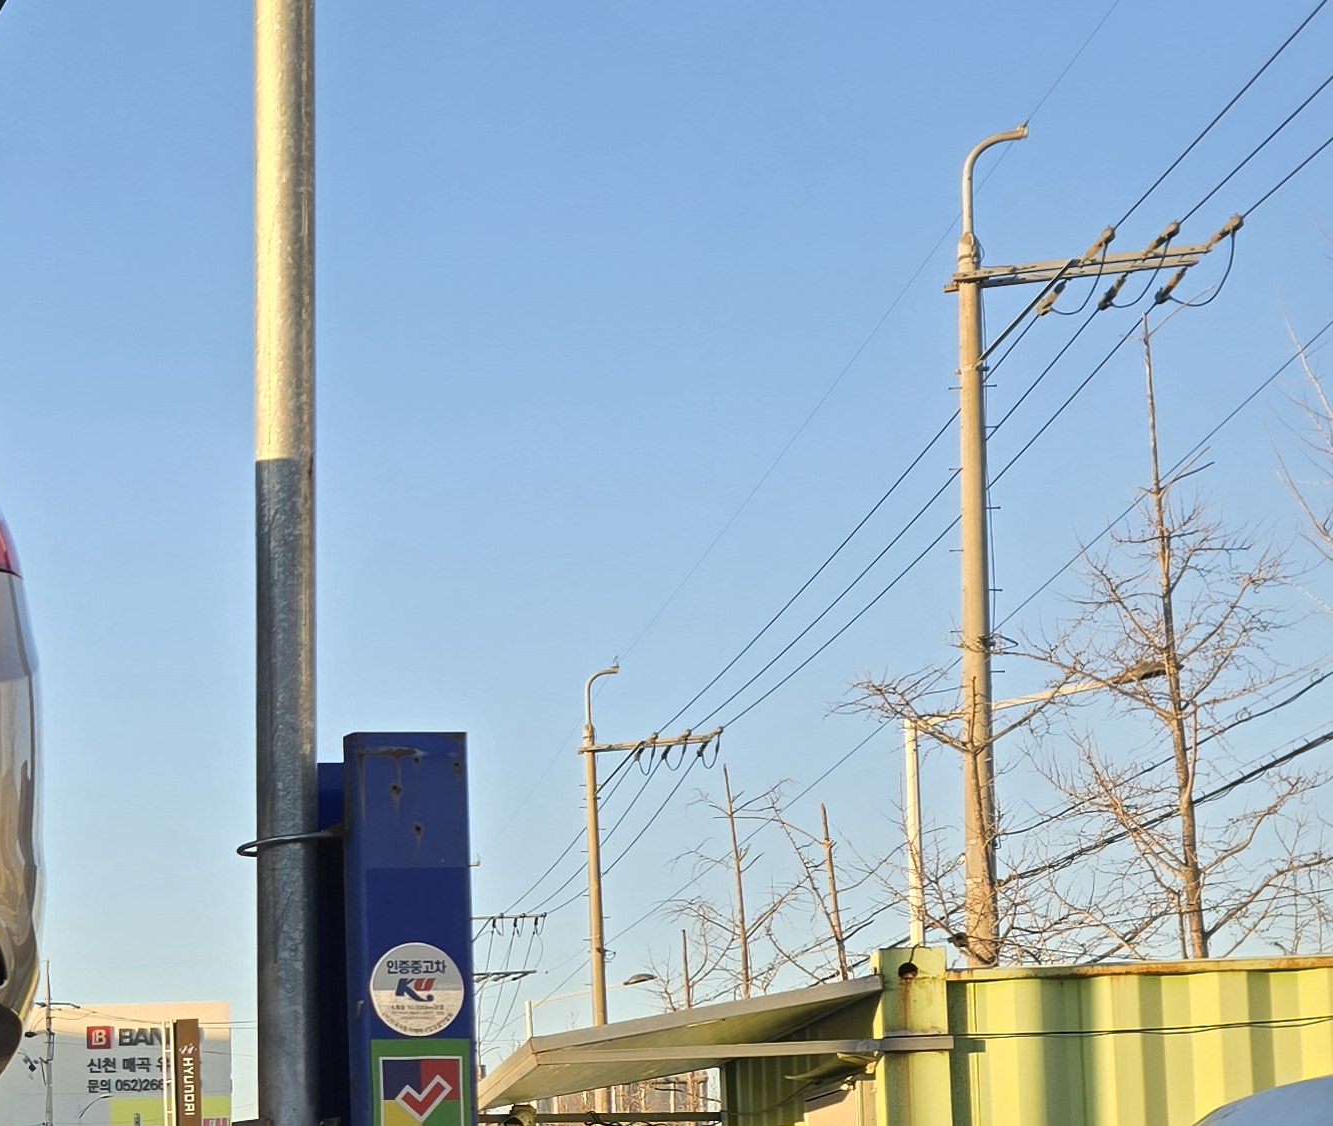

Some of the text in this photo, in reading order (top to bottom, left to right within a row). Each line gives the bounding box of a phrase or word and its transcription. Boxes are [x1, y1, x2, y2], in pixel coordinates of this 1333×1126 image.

[386, 960, 447, 975] 인증중고차
[87, 1057, 117, 1073] 신천
[122, 1056, 152, 1073] 매곡
[87, 1079, 112, 1093] 문의
[182, 1057, 196, 1116] HYUNDAI
